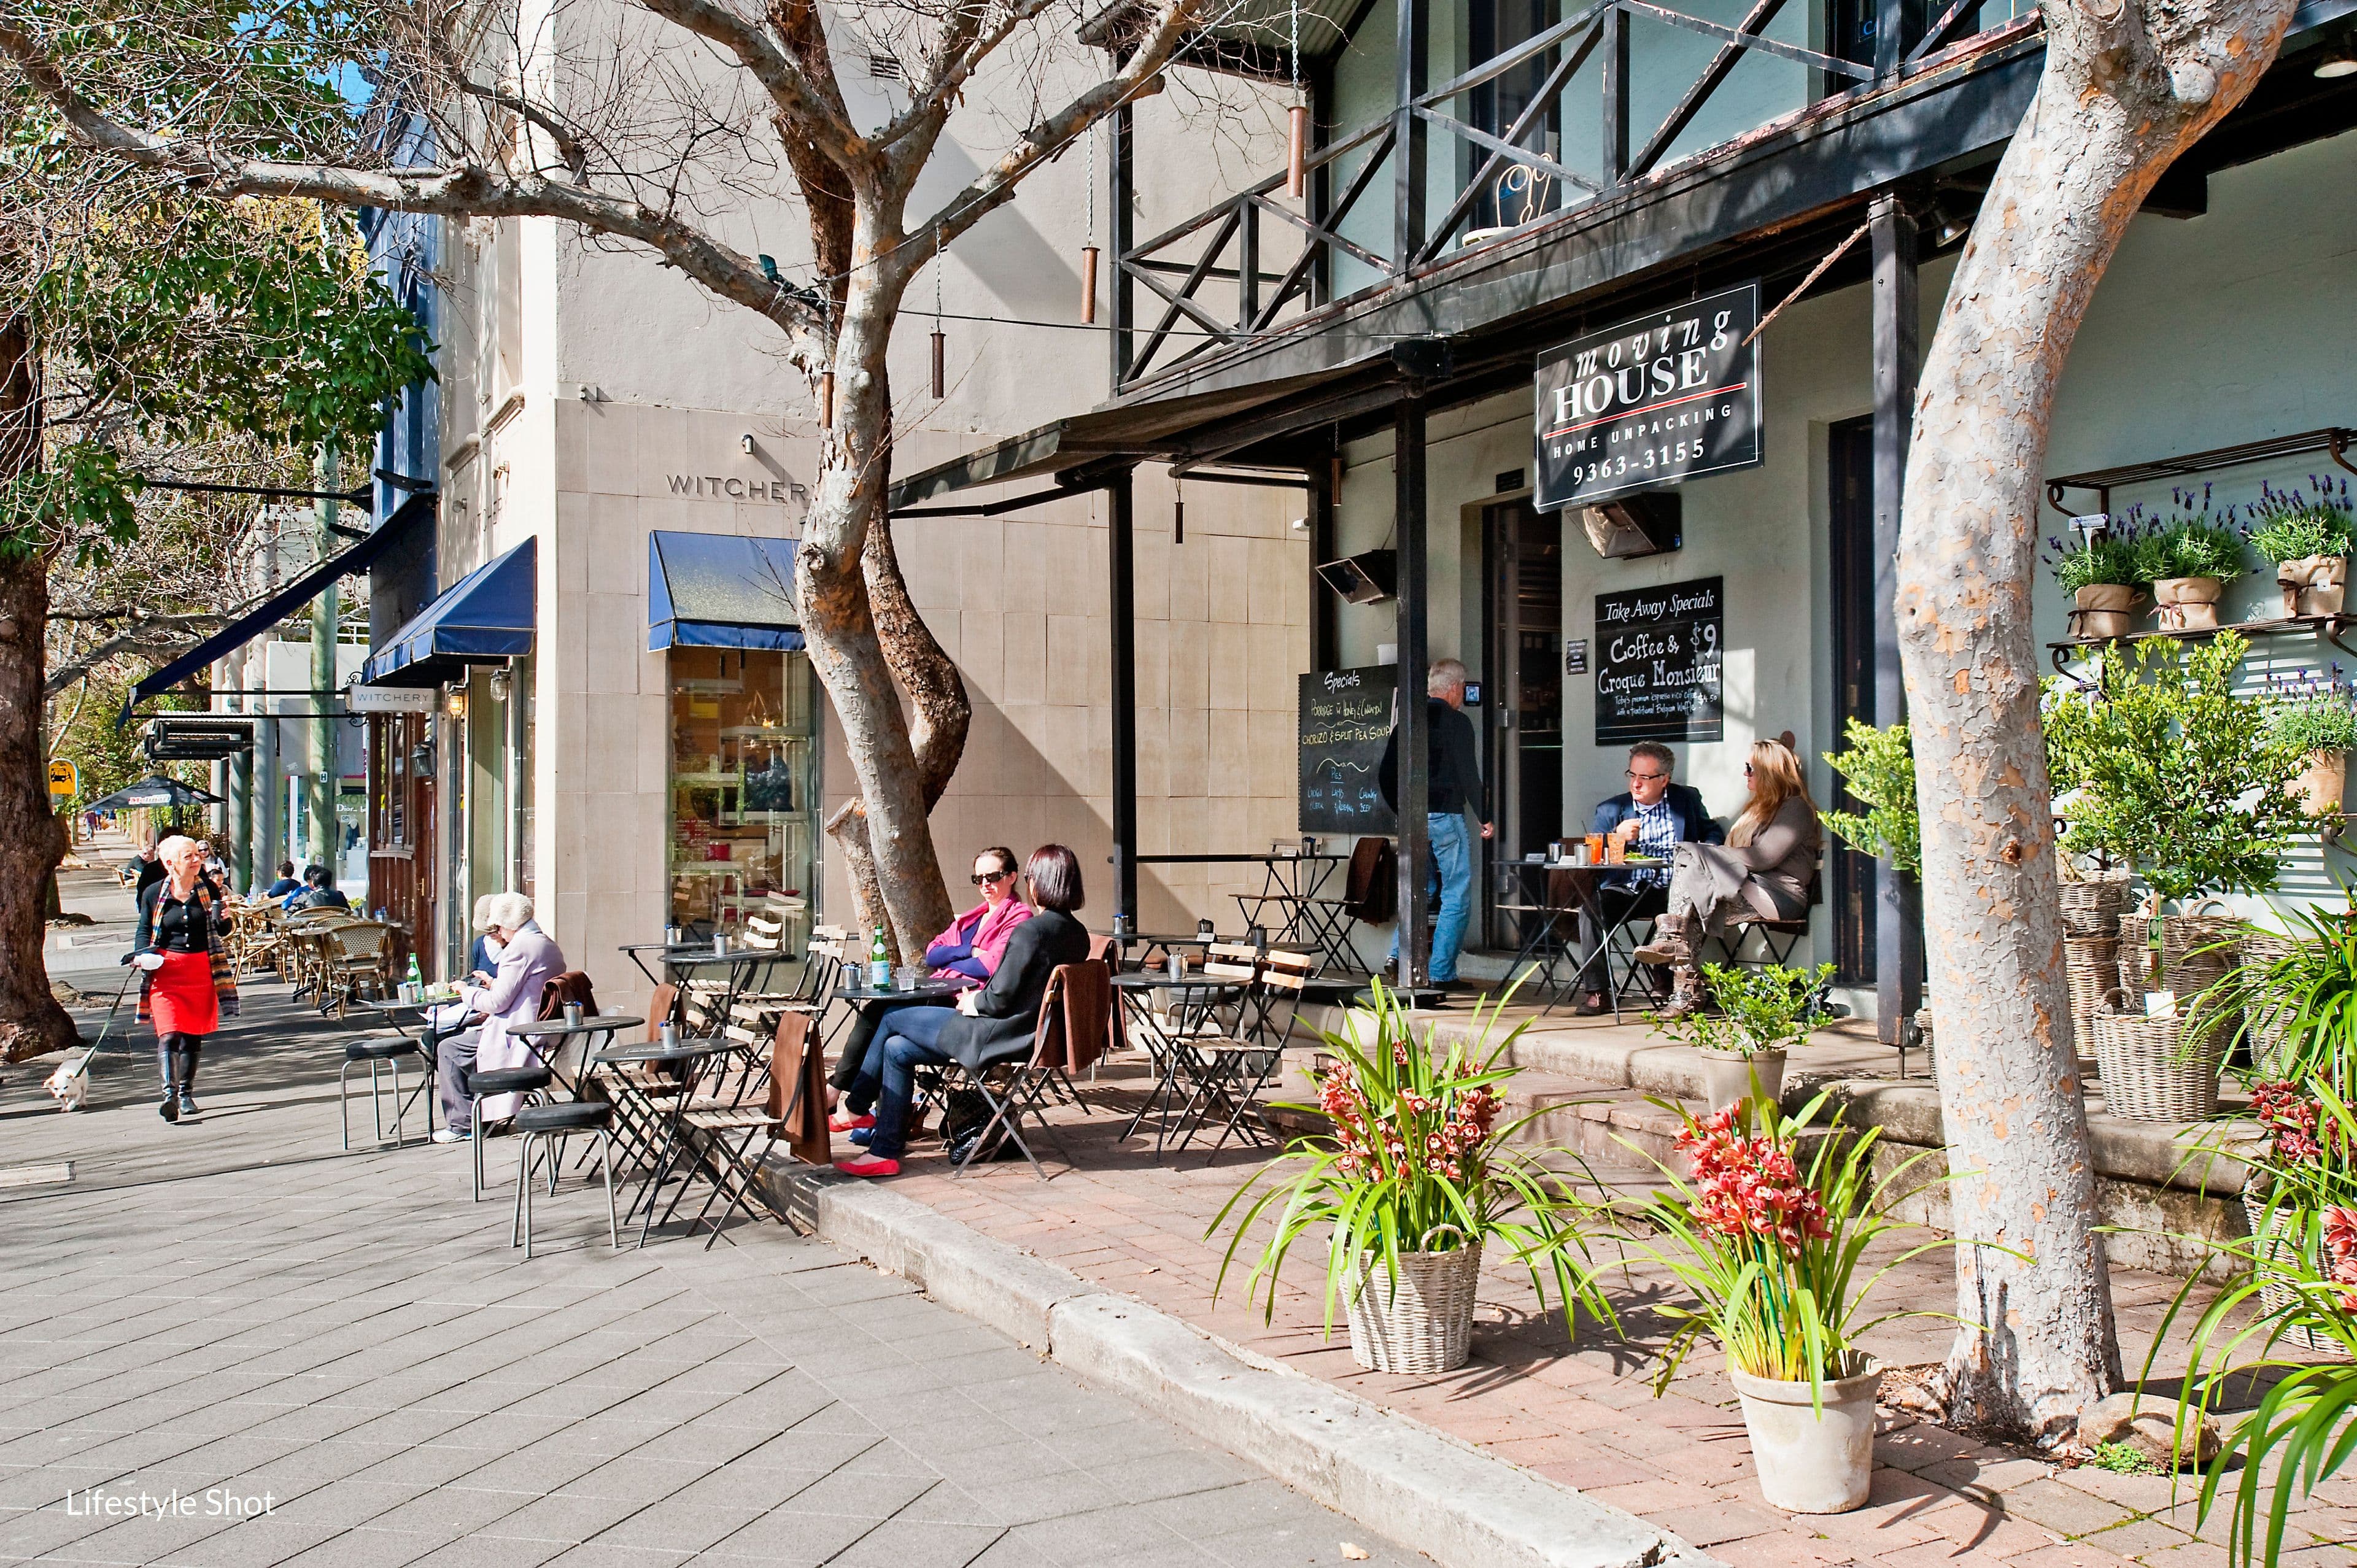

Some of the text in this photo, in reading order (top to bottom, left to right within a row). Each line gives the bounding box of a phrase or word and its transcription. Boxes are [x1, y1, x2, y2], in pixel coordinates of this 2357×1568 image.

[1576, 310, 1731, 379] moving
[1552, 346, 1709, 425] HOUSE
[1554, 404, 1731, 458] HOME UNPACKING
[1573, 438, 1704, 485] 9363-3155
[666, 474, 814, 501] WITCHER
[1606, 589, 1714, 622] Take Away Specials
[1611, 633, 1664, 663] Coffee
[1667, 635, 1679, 654] &
[1325, 670, 1360, 694] Specials
[1598, 658, 1720, 694] Croque Monsieur
[1302, 732, 1328, 745] CHORIZO
[1334, 730, 1353, 741] SPLIT
[1355, 728, 1367, 740] PEA
[1369, 726, 1391, 740] SOUP
